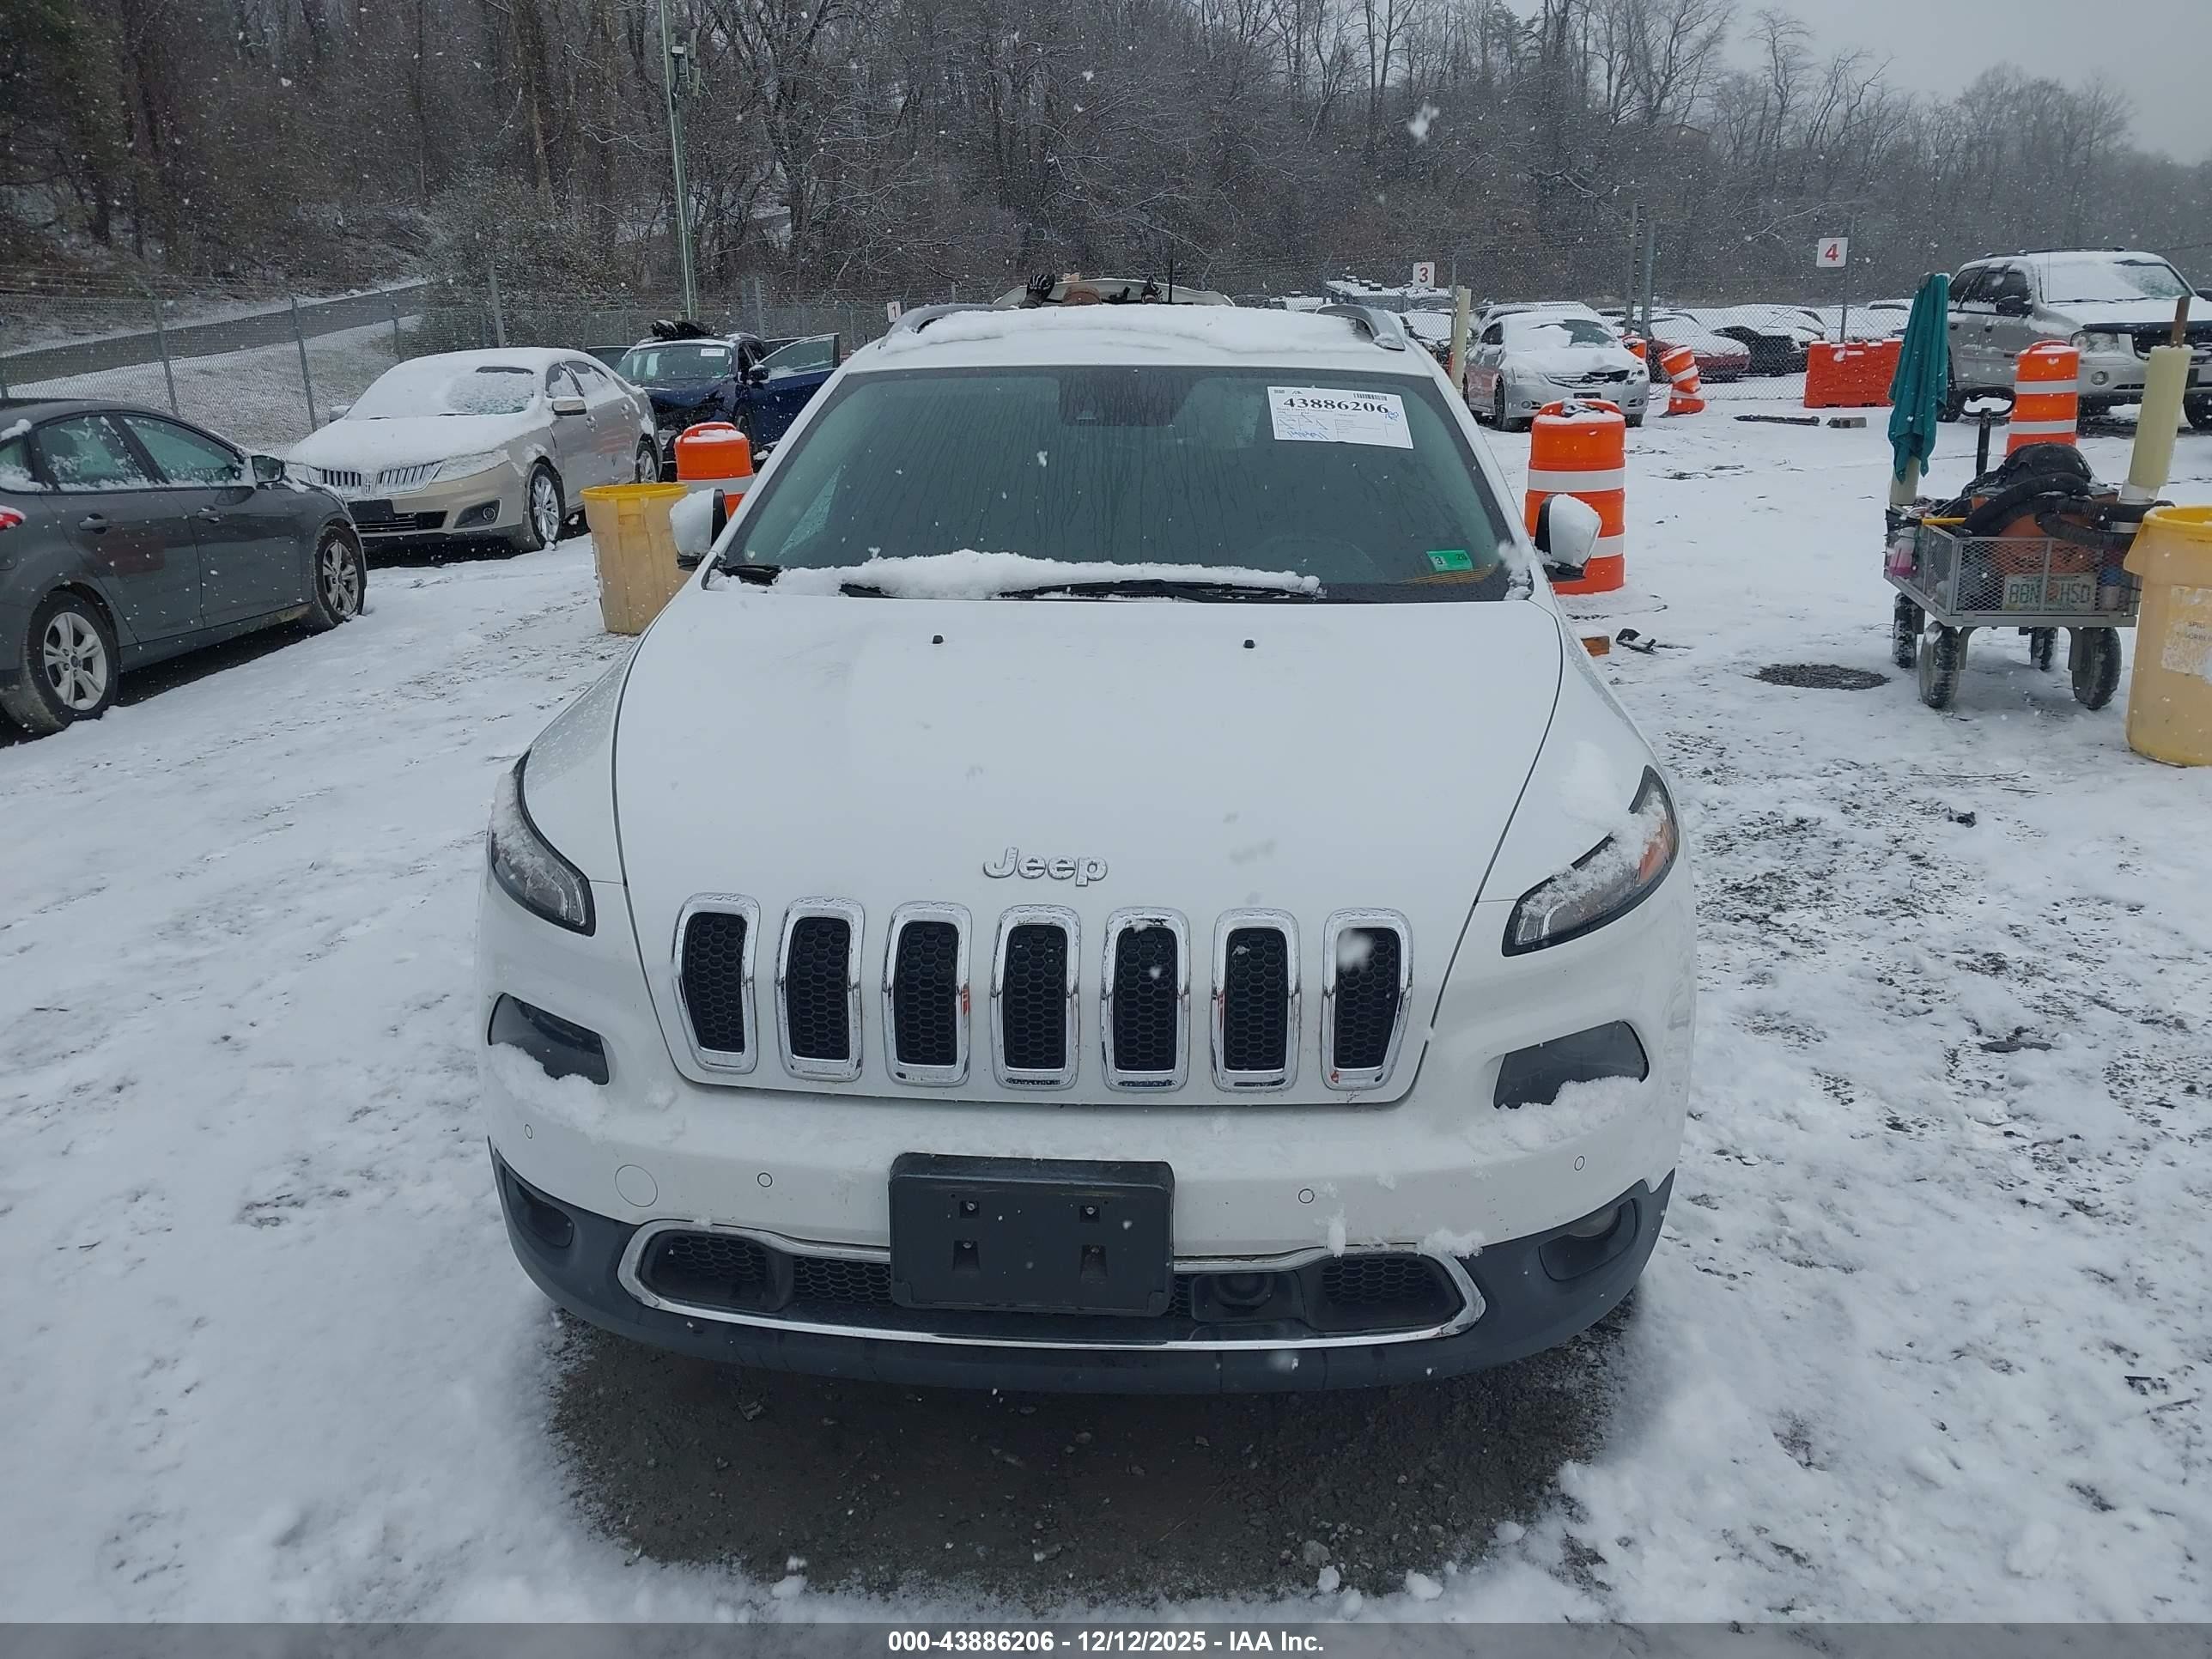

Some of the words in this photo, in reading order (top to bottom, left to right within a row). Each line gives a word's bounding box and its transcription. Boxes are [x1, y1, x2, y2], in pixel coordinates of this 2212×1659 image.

[1825, 243, 1839, 261] 4
[1419, 266, 1429, 283] 3
[891, 306, 897, 319] 1
[1283, 398, 1389, 413] 43886206
[982, 846, 1108, 887] Jeep
